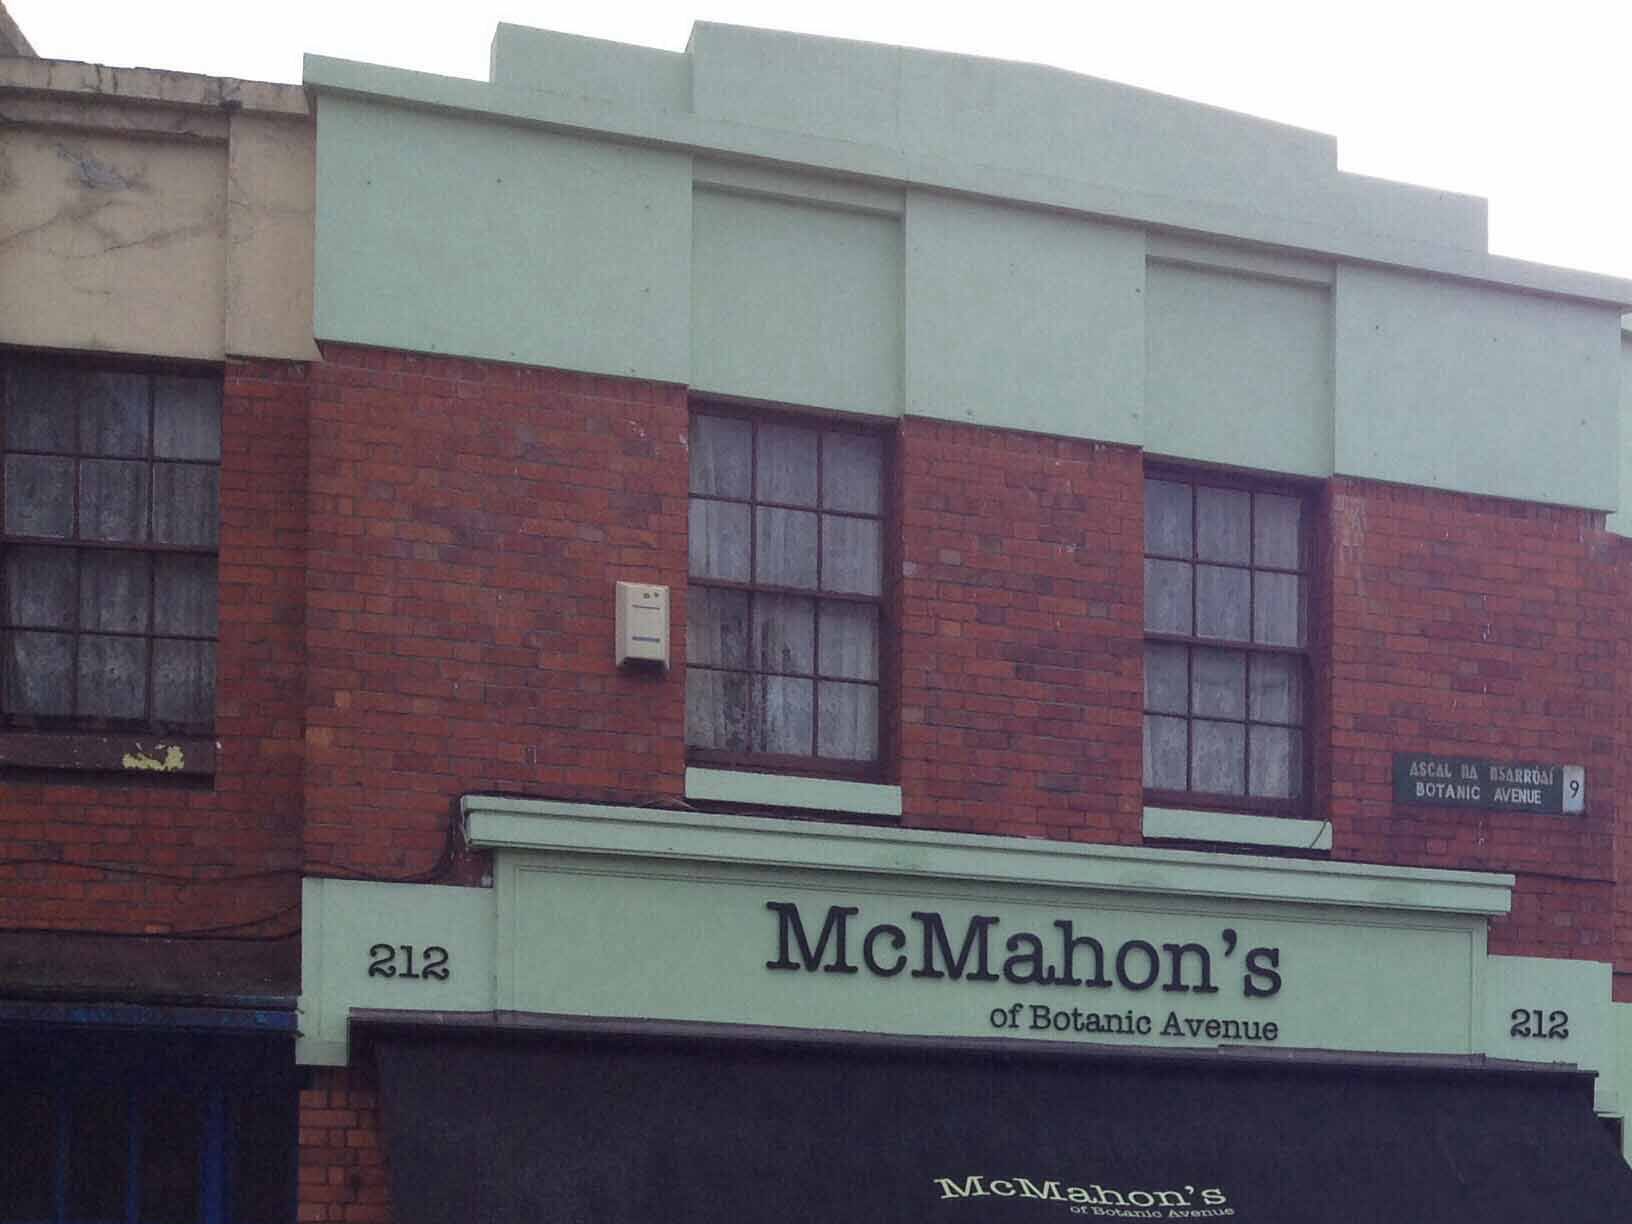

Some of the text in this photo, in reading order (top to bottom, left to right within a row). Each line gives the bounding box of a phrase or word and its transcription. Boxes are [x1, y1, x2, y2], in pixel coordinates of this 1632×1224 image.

[1415, 782, 1542, 805] BOTANIC AVENUE
[1569, 779, 1580, 798] 9
[367, 943, 451, 981] 212
[765, 900, 1283, 999] McMahon's
[989, 1002, 1279, 1041] of Botanic Avenue
[1509, 1007, 1570, 1040] 212
[933, 1174, 1228, 1207] McMahon's
[1069, 1205, 1235, 1219] of Botanic Avenue
